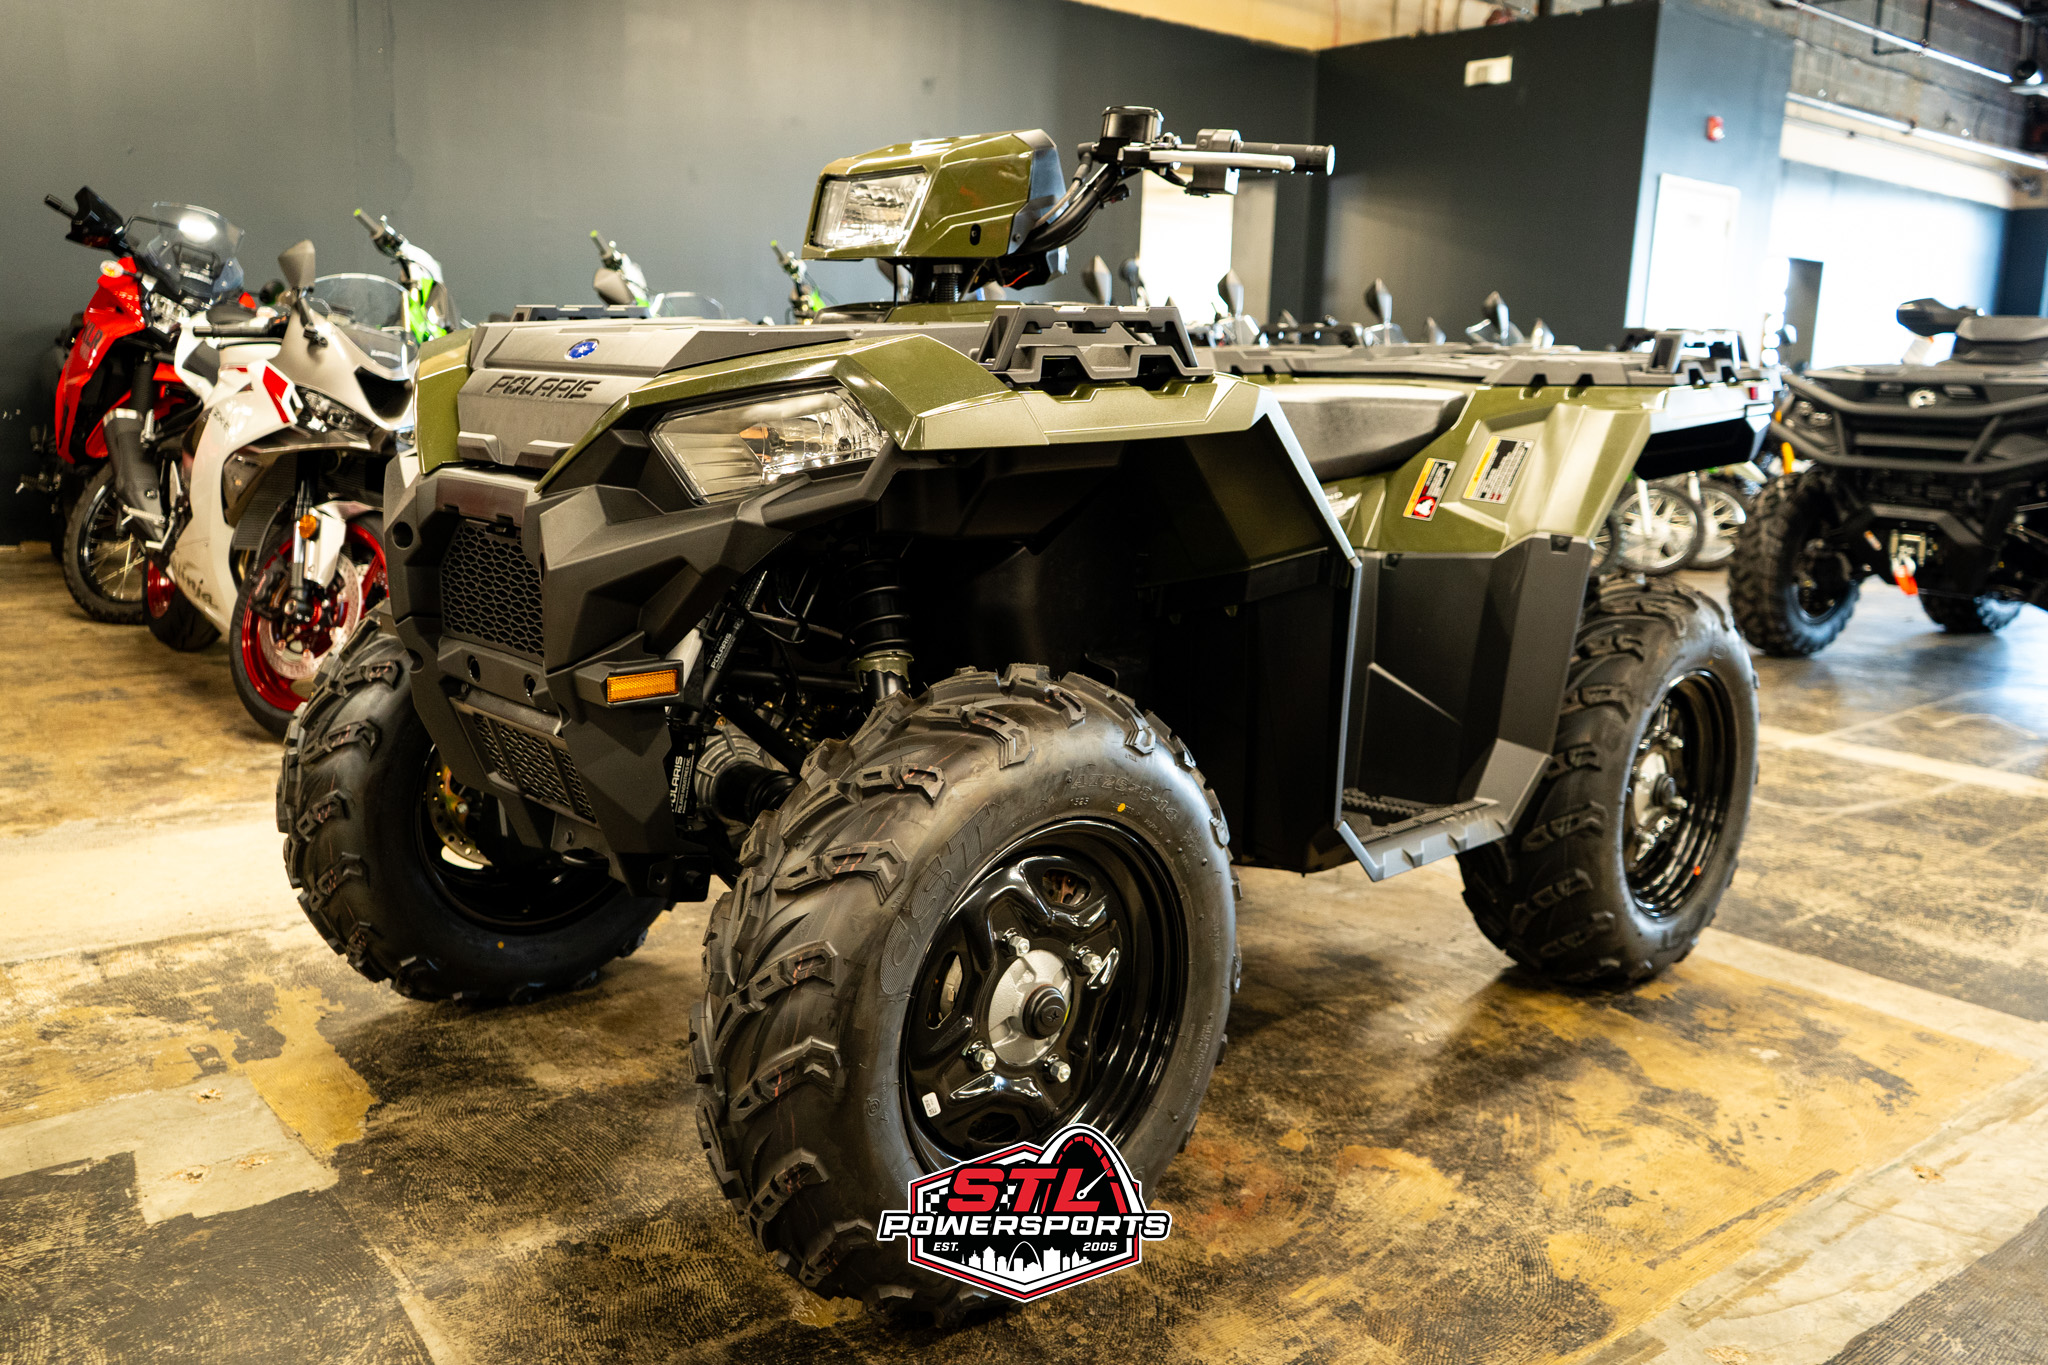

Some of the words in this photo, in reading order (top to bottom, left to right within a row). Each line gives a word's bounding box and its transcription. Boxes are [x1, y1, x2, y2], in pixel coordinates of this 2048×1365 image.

[486, 375, 601, 400] POLARIS
[710, 633, 733, 669] POLARIS
[880, 802, 992, 994] CST
